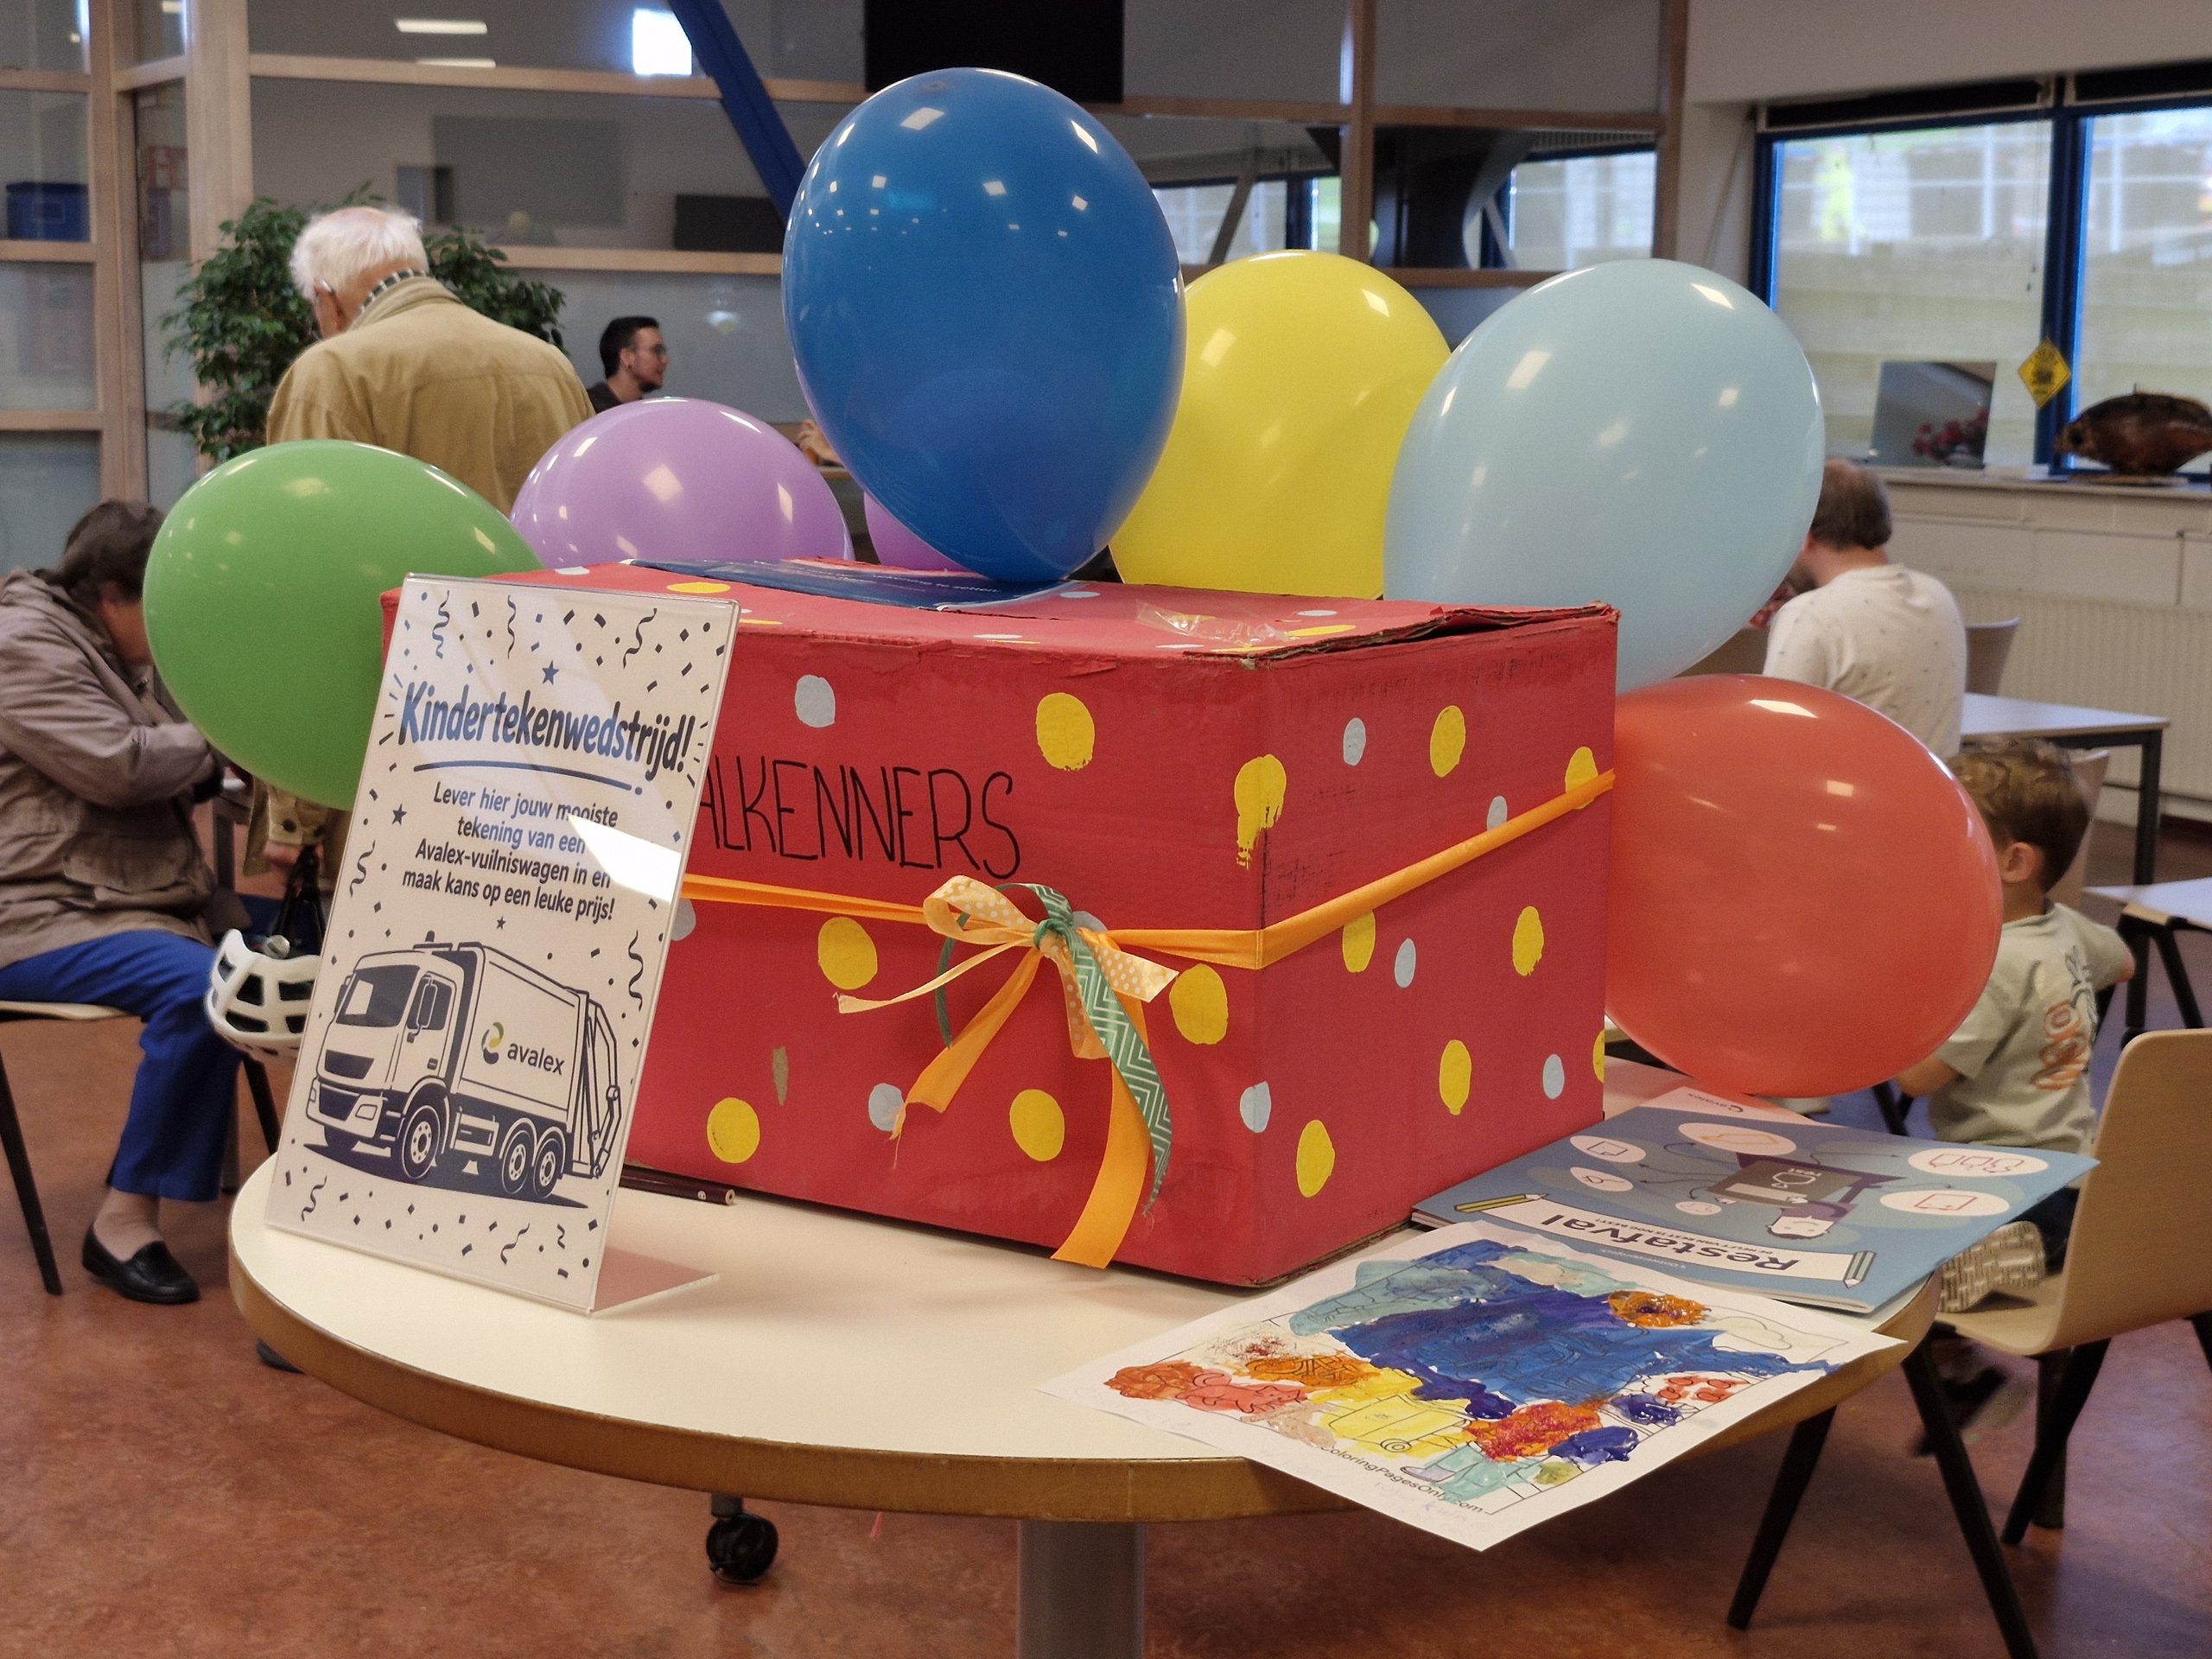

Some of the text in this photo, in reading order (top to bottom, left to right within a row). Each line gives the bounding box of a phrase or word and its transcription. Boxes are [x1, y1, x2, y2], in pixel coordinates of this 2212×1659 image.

[399, 680, 696, 781] Kindertekenwedstrijd!
[433, 781, 619, 828] Lever hier jouw mooiste
[458, 815, 586, 854] tekening van een
[415, 838, 611, 888] Avalex-vuilniswagen in en
[402, 868, 616, 925] maak kans op een leuke prijs!
[506, 1039, 565, 1076] avalex
[1541, 1213, 1800, 1270] Restafval
[1319, 1445, 1484, 1514] oloringPagesOnlom
